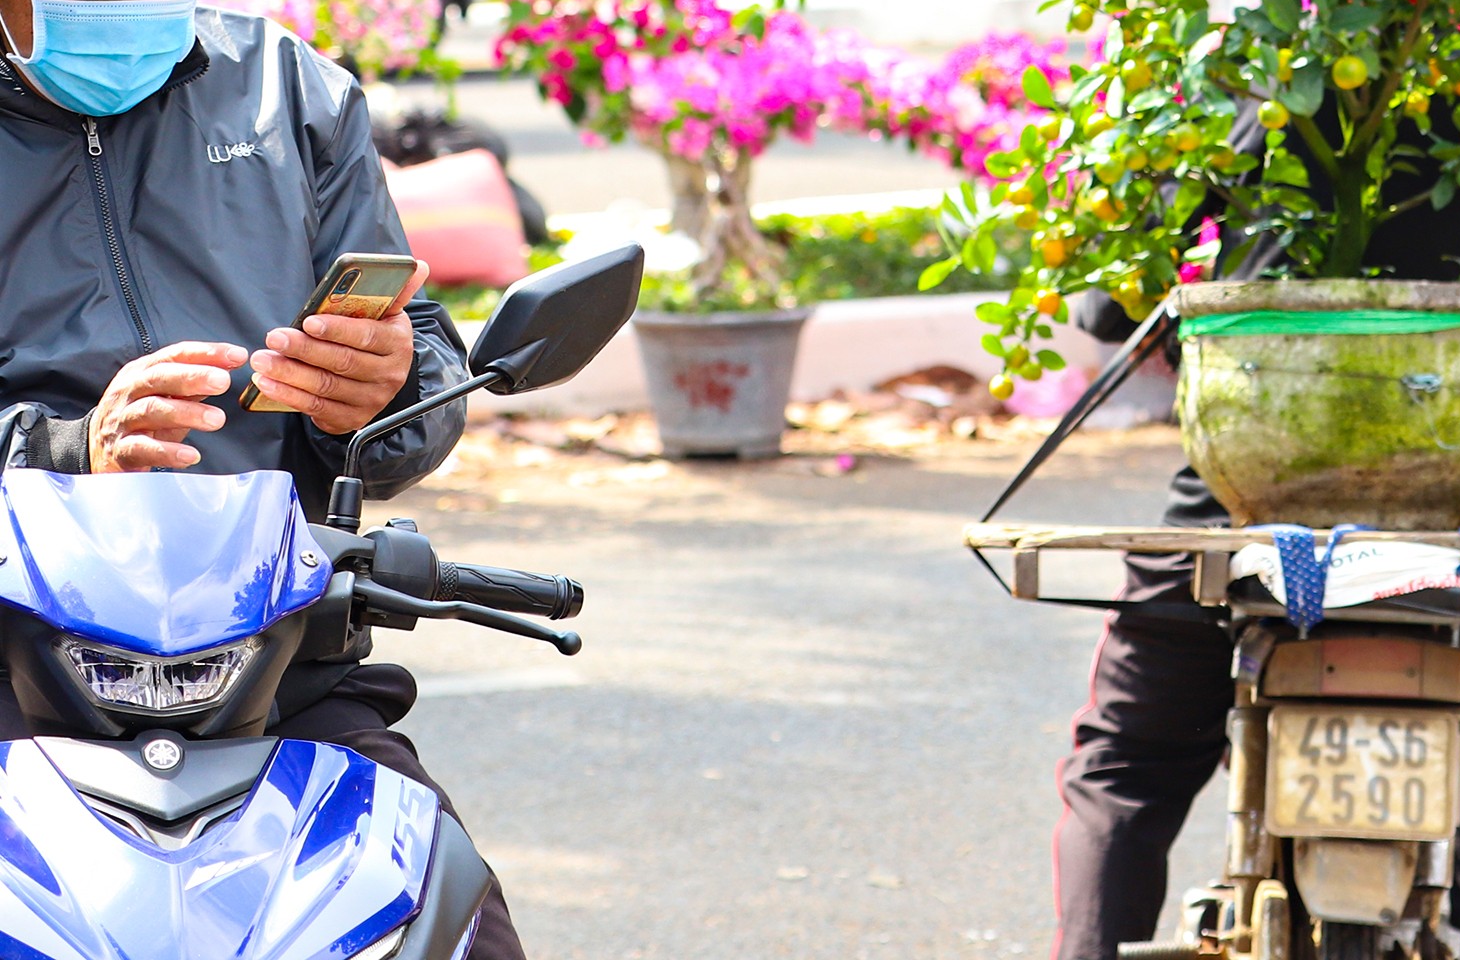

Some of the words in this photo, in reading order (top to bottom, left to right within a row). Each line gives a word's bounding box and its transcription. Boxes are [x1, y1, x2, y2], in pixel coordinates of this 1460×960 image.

[1331, 548, 1384, 569] OTAL
[1298, 716, 1428, 769] 49-S6
[1296, 774, 1426, 827] 2590
